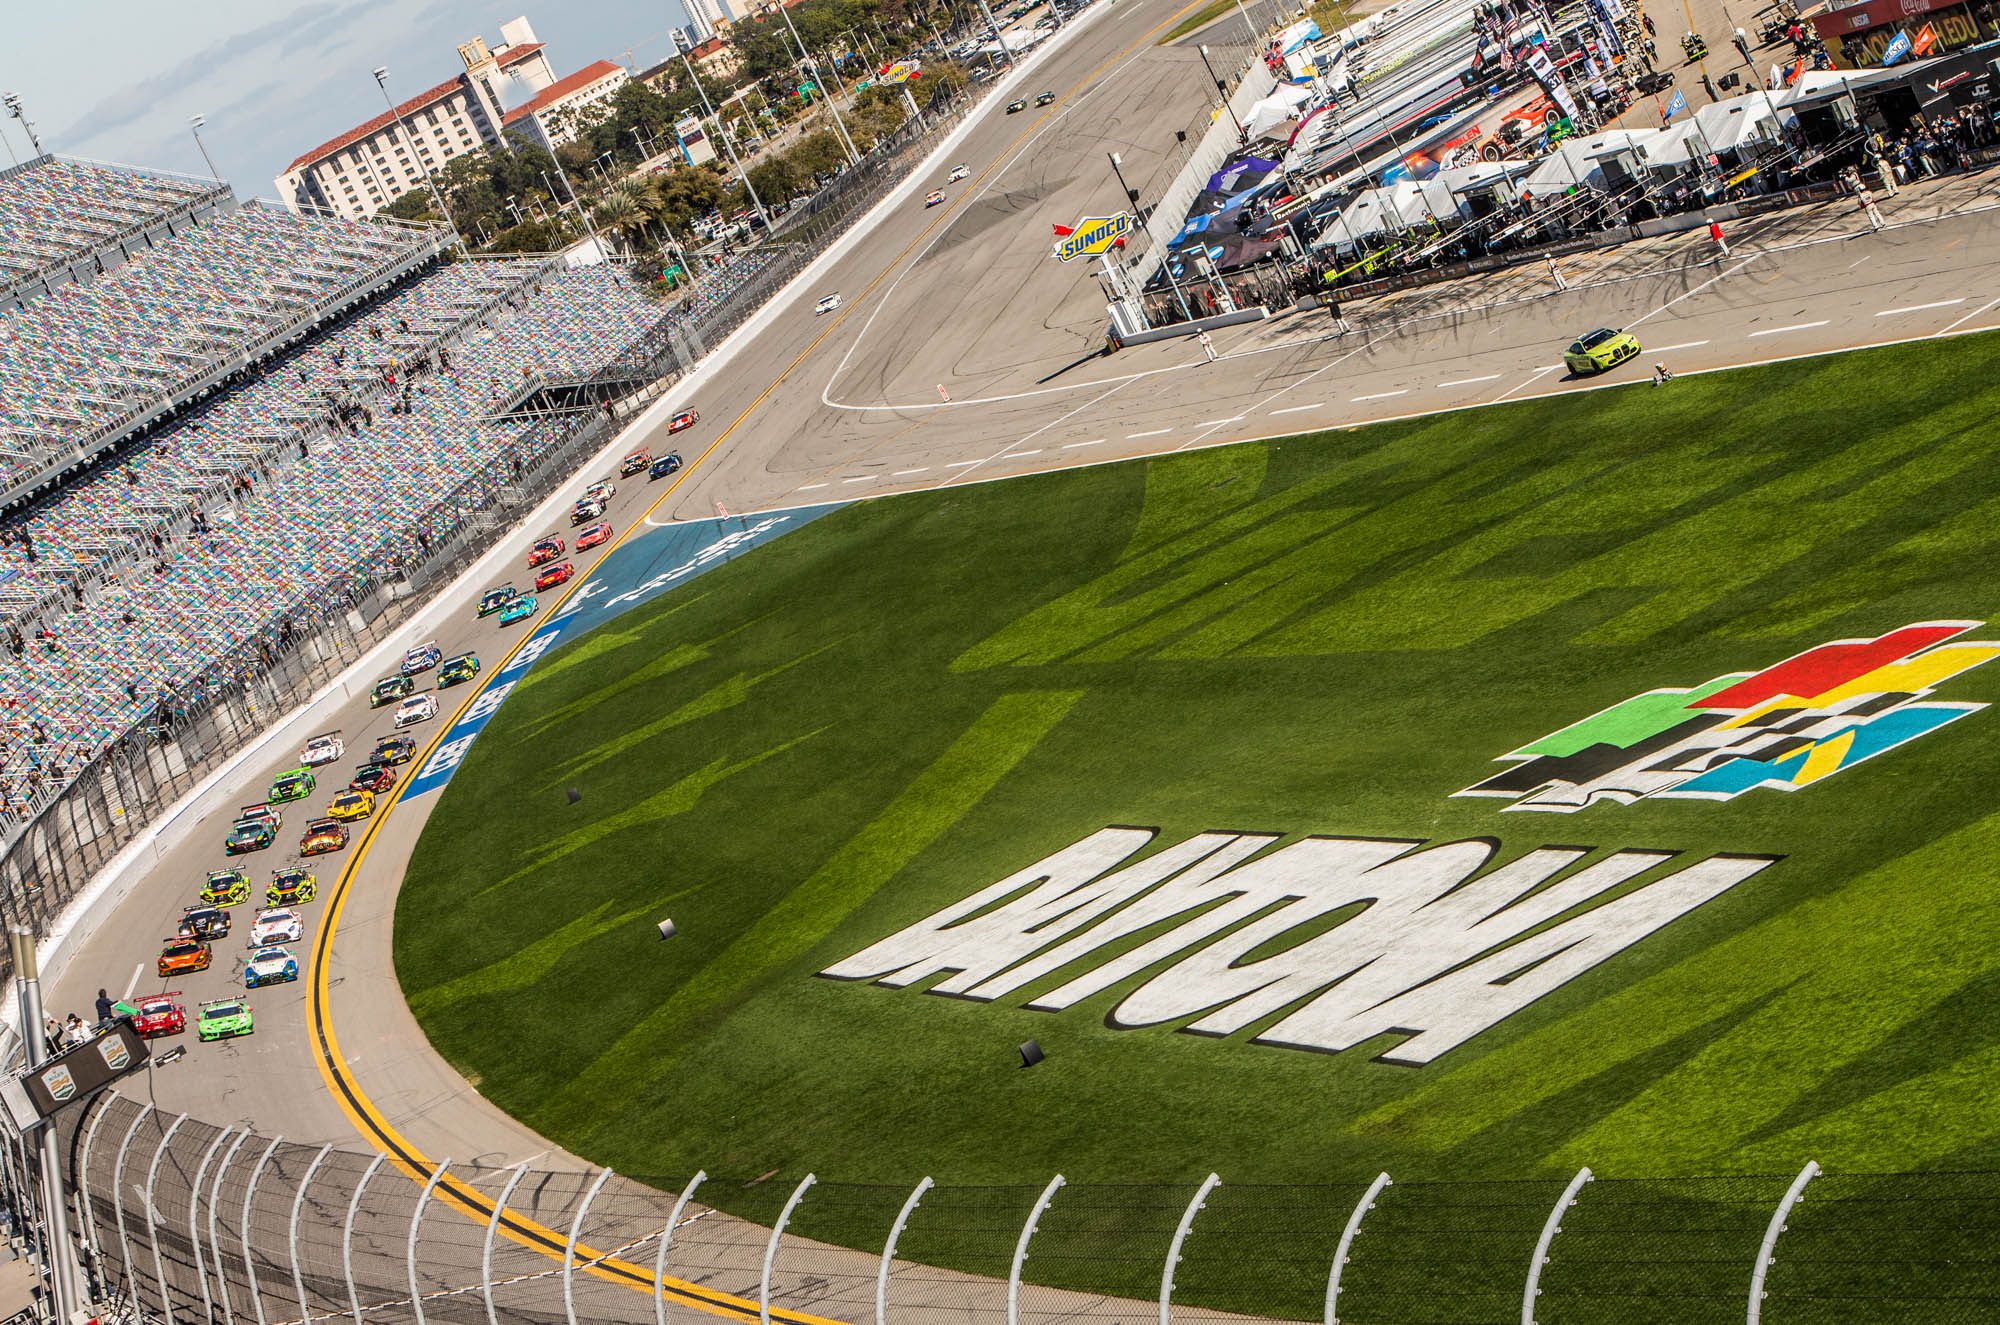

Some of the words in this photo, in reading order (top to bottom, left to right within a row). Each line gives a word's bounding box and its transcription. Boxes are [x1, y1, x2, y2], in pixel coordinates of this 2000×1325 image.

[883, 62, 915, 83] SUNOCO
[1548, 75, 1561, 88] 31
[1064, 215, 1126, 257] SUNOCO
[817, 825, 1787, 1066] DAYTONA
